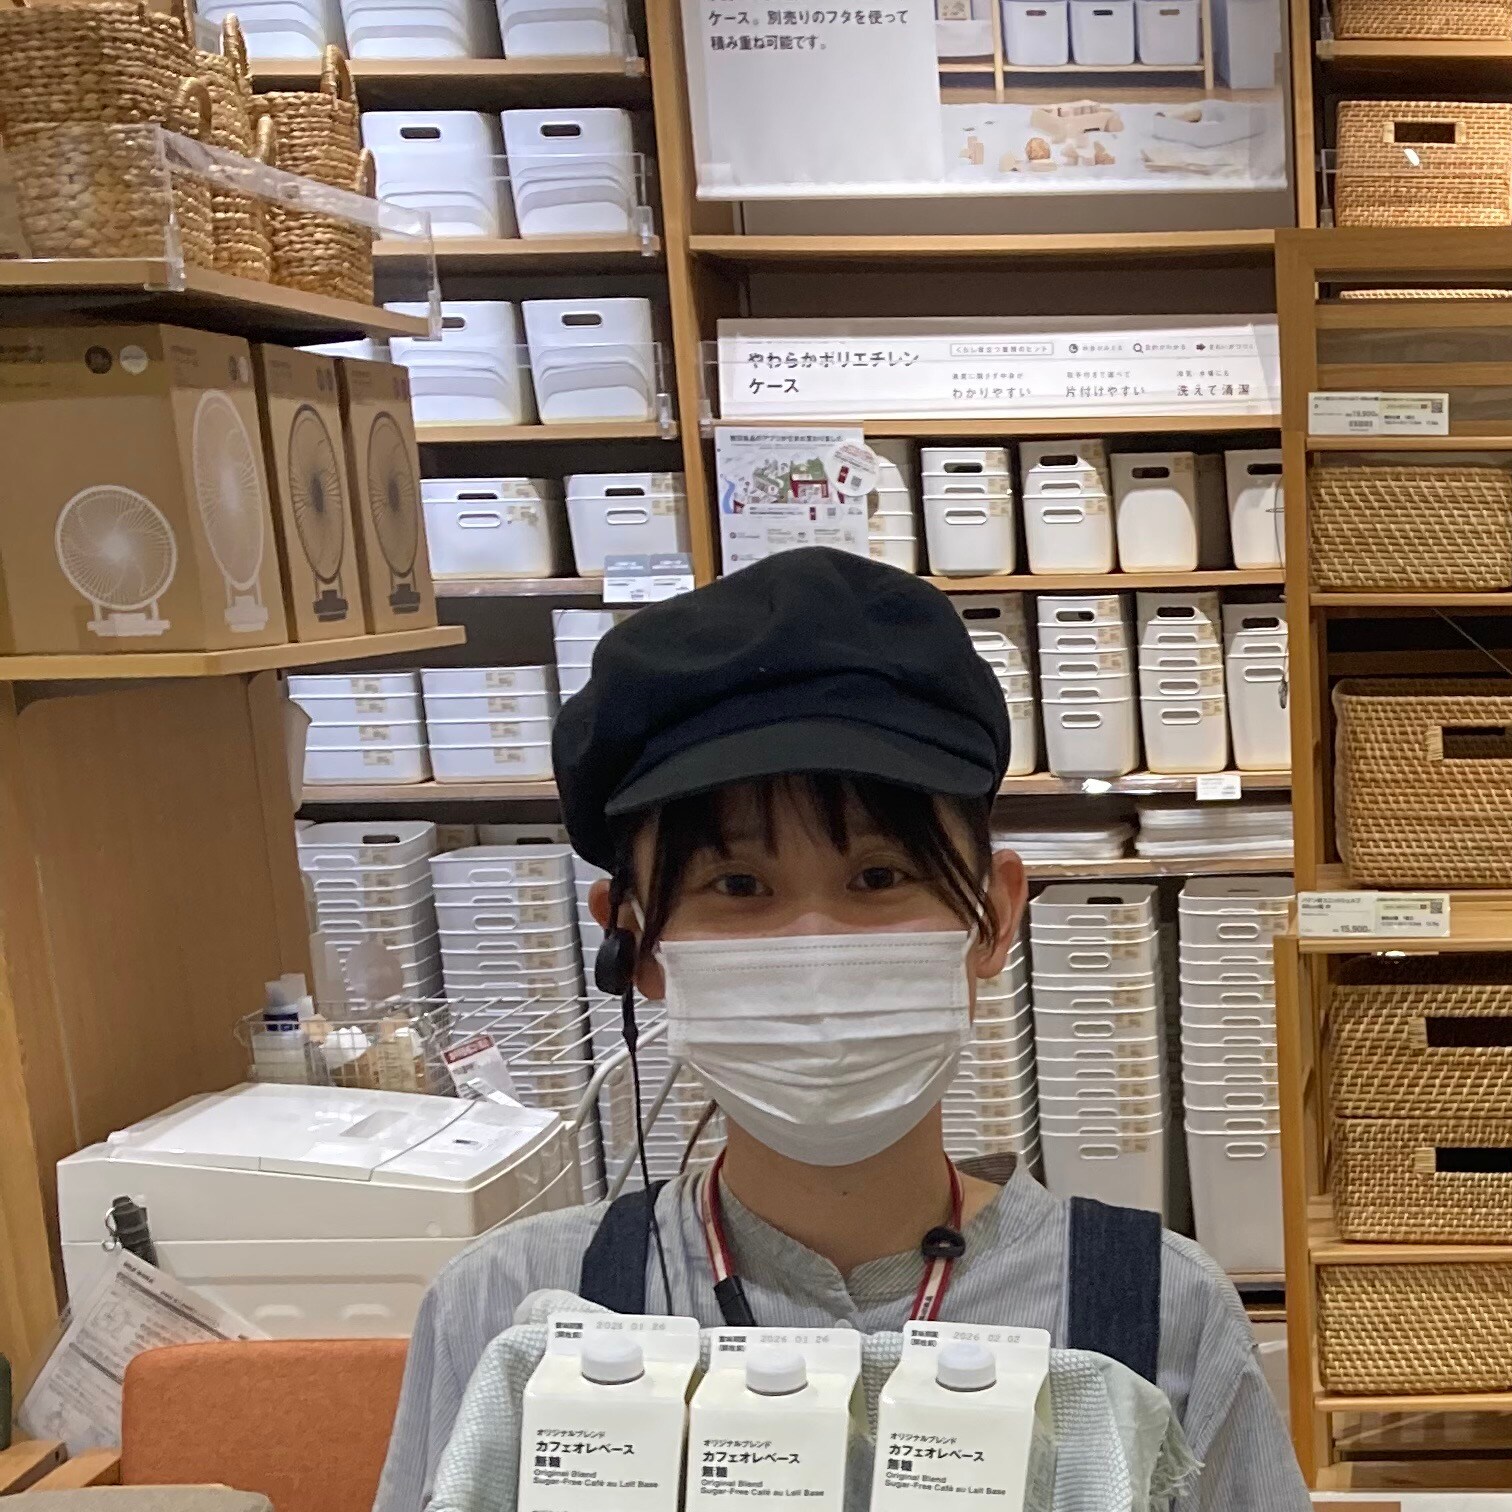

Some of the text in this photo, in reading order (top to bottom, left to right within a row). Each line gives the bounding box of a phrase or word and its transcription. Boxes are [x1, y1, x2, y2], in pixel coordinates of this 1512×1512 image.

[708, 10, 909, 26] ケース。別売りのフタを使って
[710, 34, 827, 51] 積み重ね可能です。
[749, 350, 919, 369] やわらかポリエチレン
[749, 377, 800, 395] ケース
[1065, 385, 1146, 398] 片付けやすい
[952, 387, 1032, 399] わかりやすい
[536, 1428, 606, 1439] オリジナルブレンド
[890, 1432, 957, 1445] オリジナルブレンド
[535, 1440, 635, 1455] カフェオレベース
[703, 1439, 772, 1449] オリジナルブレンド
[702, 1450, 800, 1464] カフェオレベース
[888, 1443, 985, 1462] カフェオレベース
[534, 1456, 561, 1468] 無糖
[886, 1458, 913, 1472] 無糖
[533, 1469, 597, 1478] Original Blend
[701, 1466, 728, 1478] 無糖
[885, 1471, 947, 1484] Original Blend
[701, 1479, 763, 1488] Original Blend
